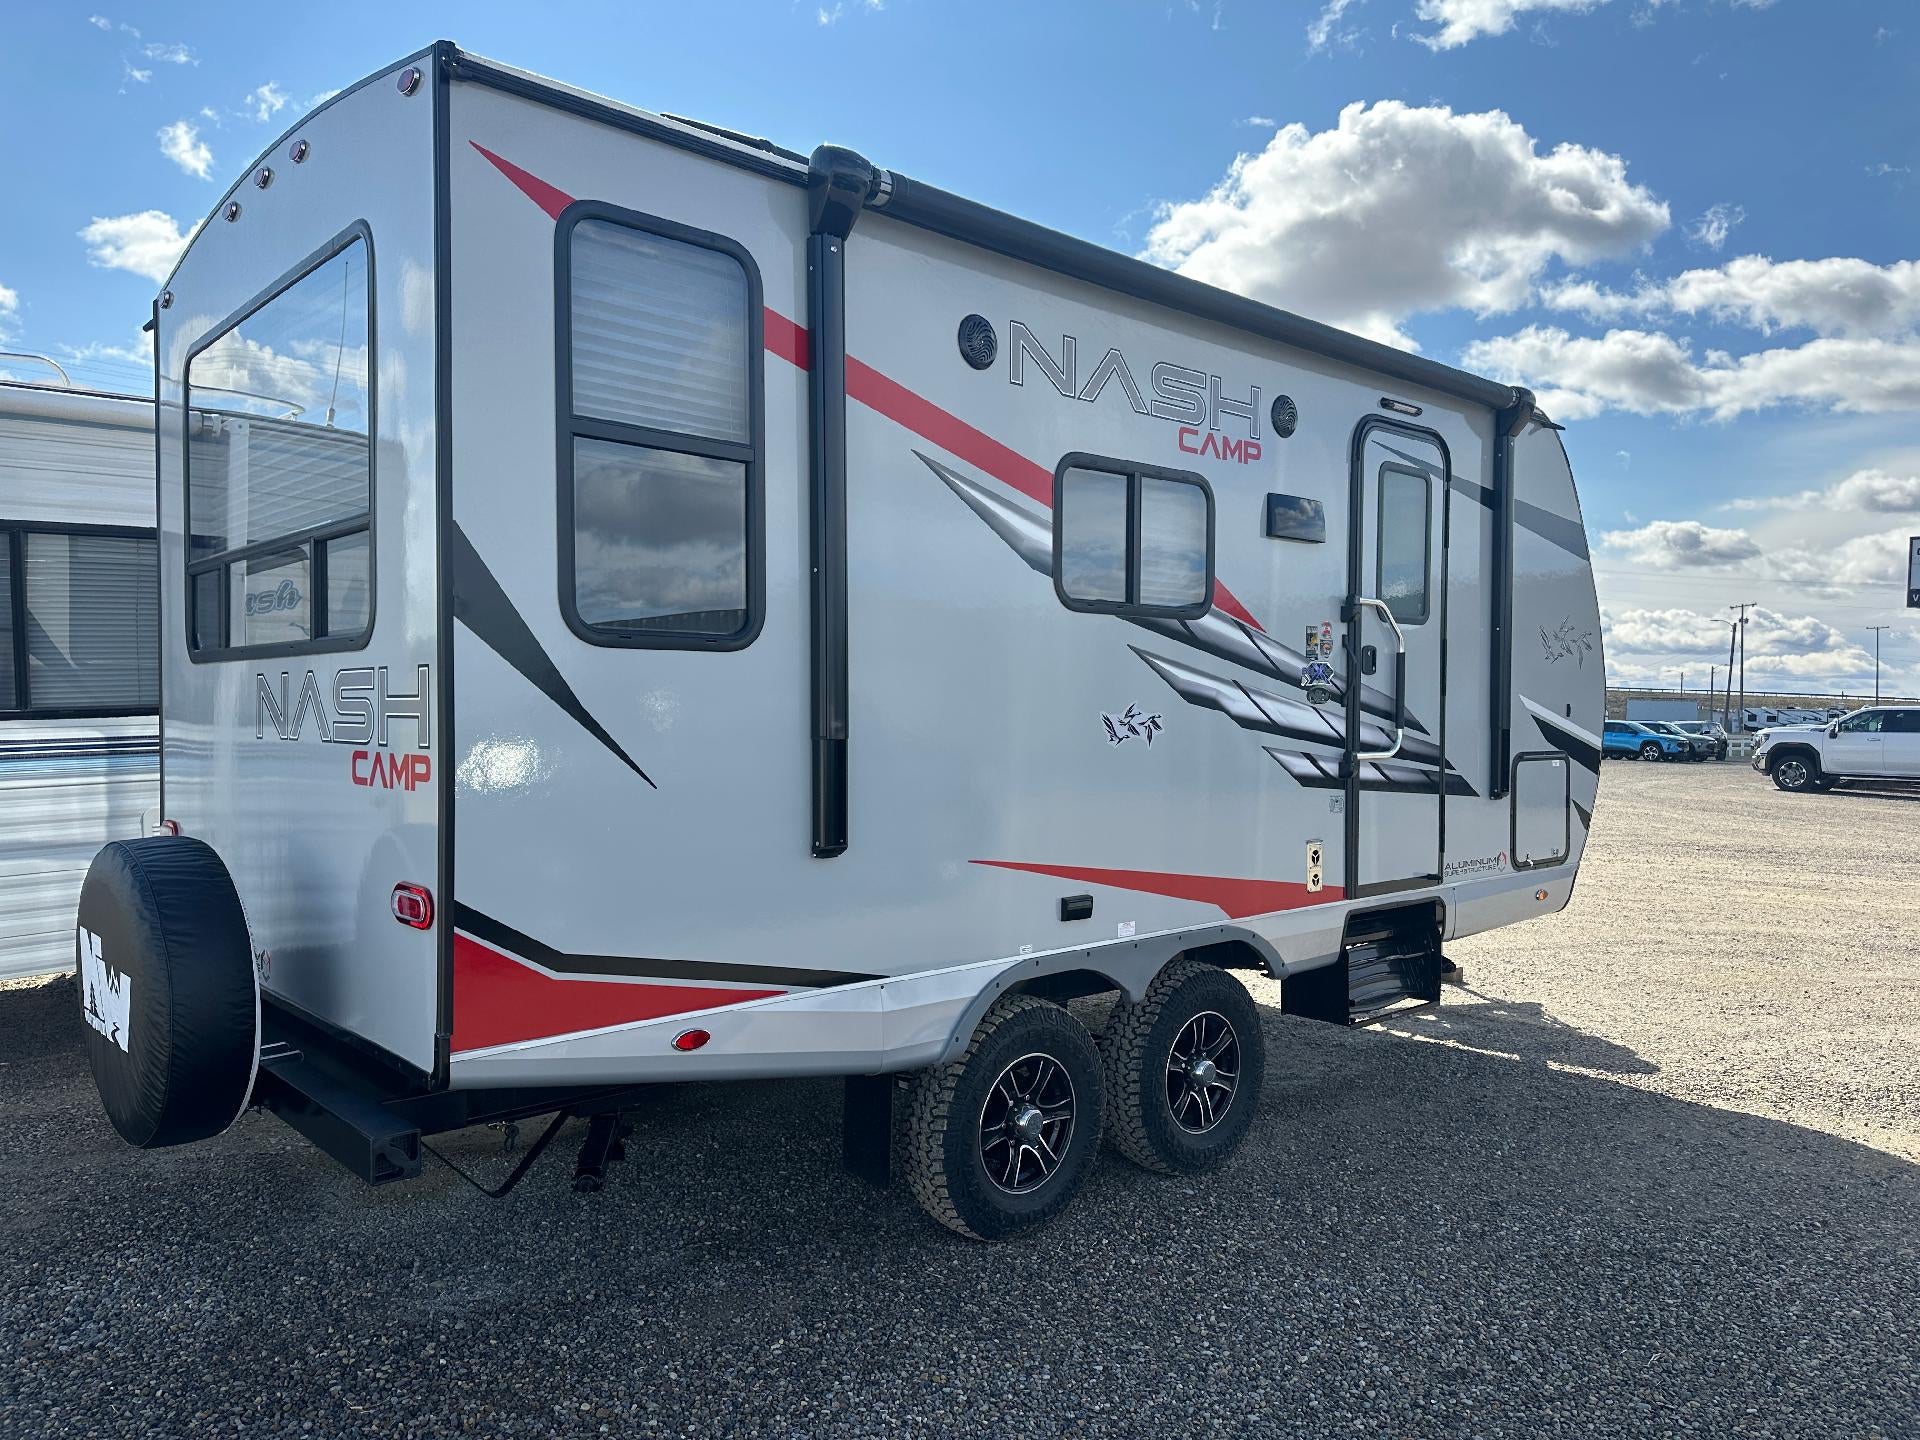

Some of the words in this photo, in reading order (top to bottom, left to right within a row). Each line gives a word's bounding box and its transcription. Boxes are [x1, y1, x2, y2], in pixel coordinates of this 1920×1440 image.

[1009, 320, 1261, 440] NASH
[1178, 426, 1262, 464] CAMP
[256, 664, 431, 749] NASH
[352, 750, 431, 791] CAMP
[1444, 856, 1497, 870] ALUMINUM
